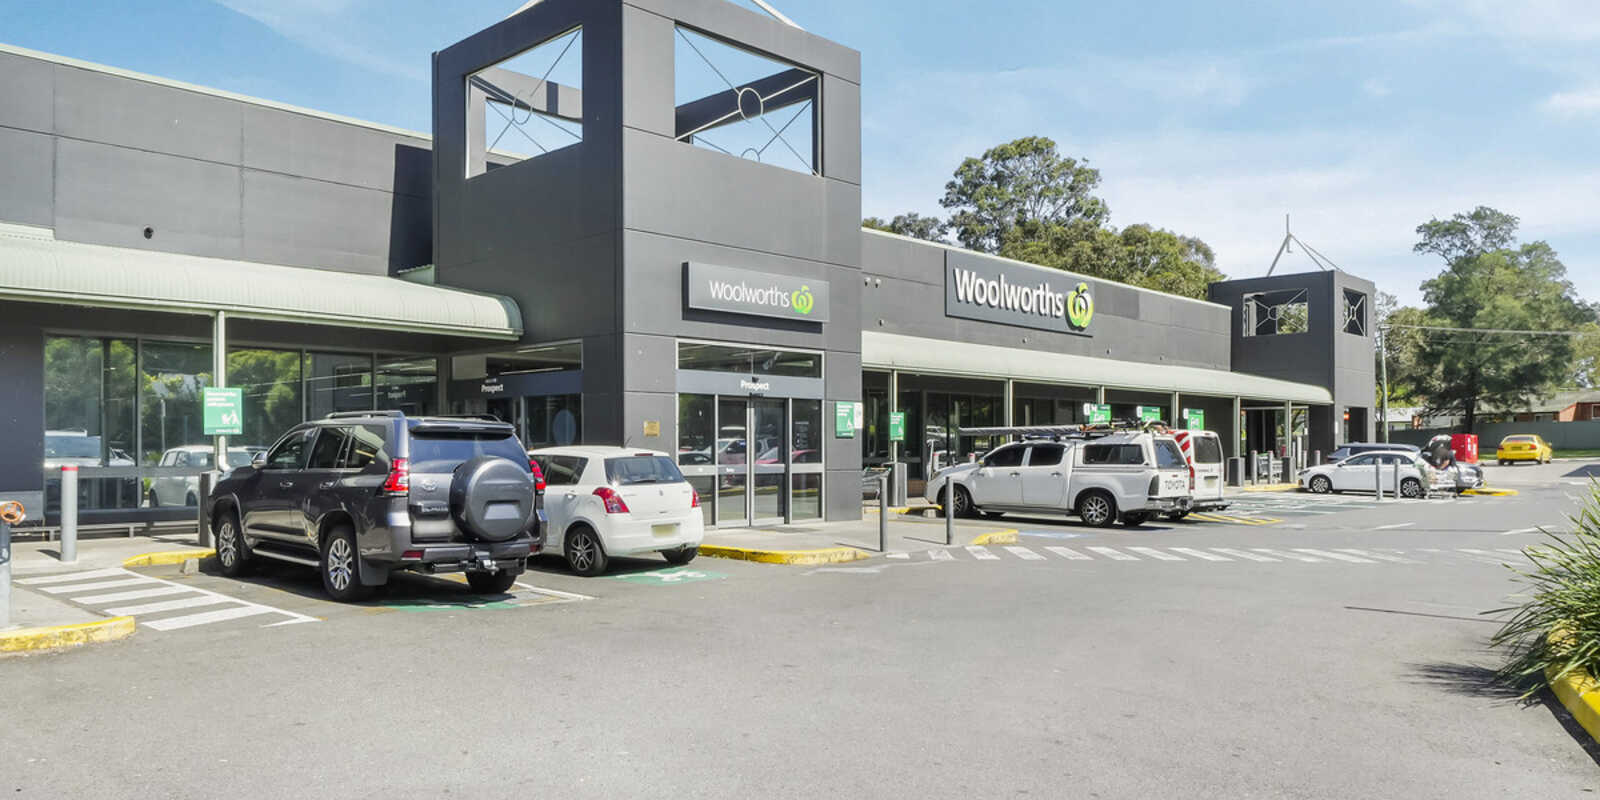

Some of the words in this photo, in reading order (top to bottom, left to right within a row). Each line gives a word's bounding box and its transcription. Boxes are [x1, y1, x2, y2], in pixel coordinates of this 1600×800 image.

[709, 280, 790, 307] Woolworths
[954, 268, 1064, 317] Woolworths
[481, 384, 504, 393] Prospect
[741, 380, 769, 391] Prospect
[1164, 480, 1185, 490] TOYOTA
